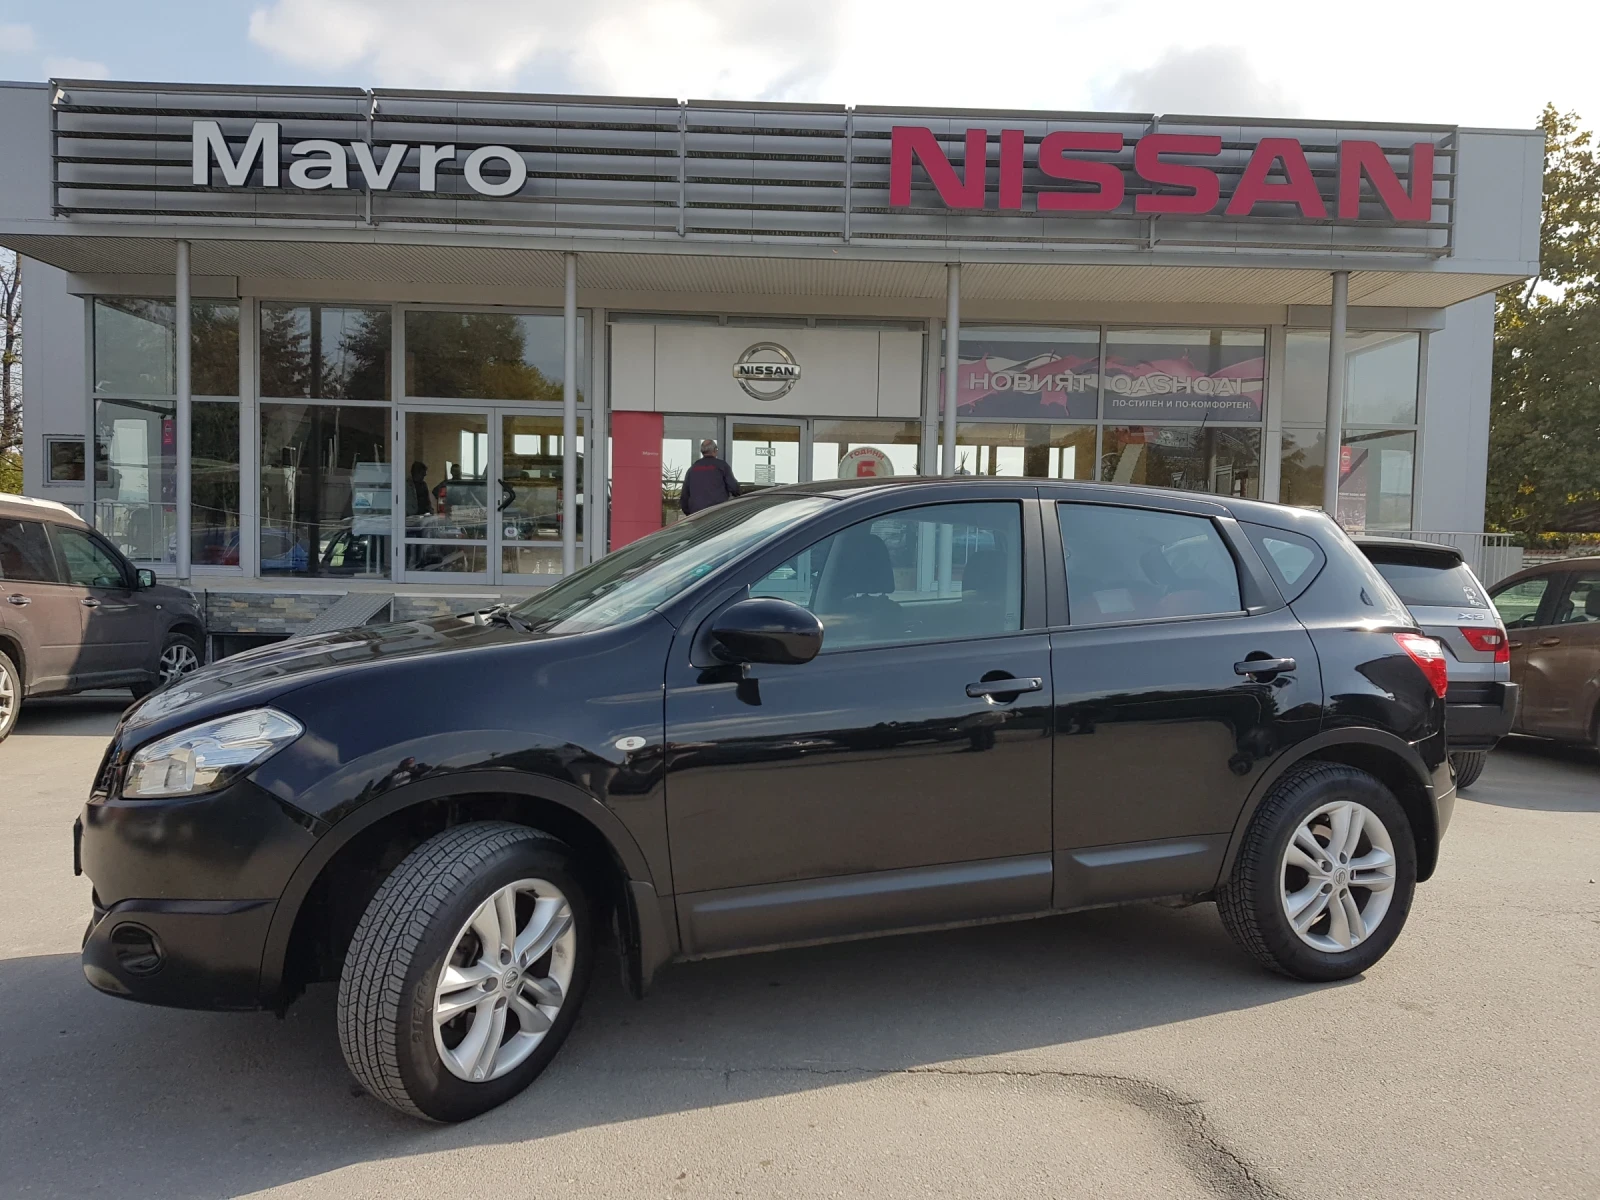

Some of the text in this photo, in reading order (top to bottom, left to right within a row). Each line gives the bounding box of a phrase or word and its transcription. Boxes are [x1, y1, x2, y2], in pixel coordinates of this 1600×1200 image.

[192, 120, 527, 197] Mavro
[889, 126, 1435, 221] NISSAN
[739, 365, 794, 376] NISSAN
[969, 372, 1243, 397] НОВИЯТ QASHQAI
[1112, 399, 1252, 409] ПО-СТИЛЕН И ПО-КОМФОРТЕН!
[848, 448, 885, 461] ГОДИНИ
[1457, 612, 1485, 621] X3
